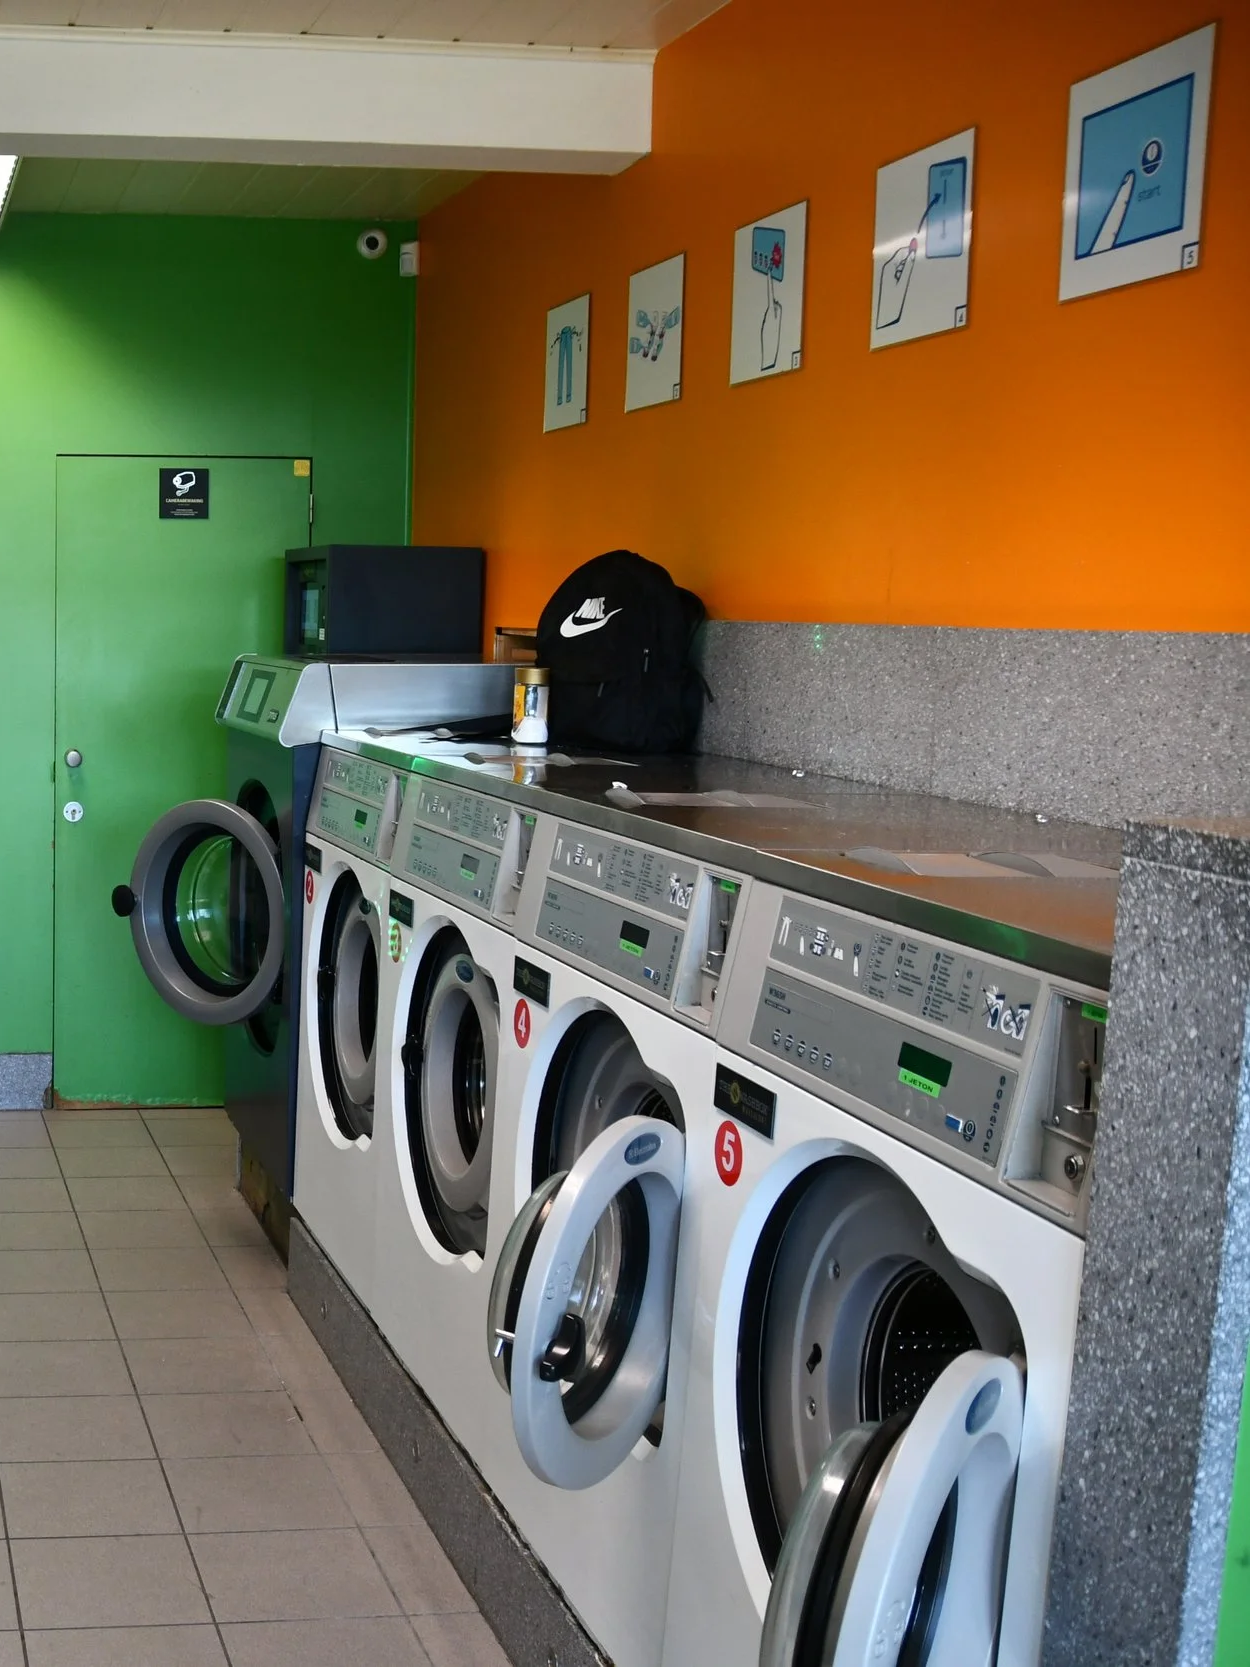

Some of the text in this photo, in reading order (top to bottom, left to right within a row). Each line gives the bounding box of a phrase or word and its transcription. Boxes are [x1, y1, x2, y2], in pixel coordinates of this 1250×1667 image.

[1137, 184, 1161, 202] start
[1187, 250, 1194, 265] 5
[574, 597, 606, 619] NIKE
[307, 875, 313, 897] 2
[517, 1007, 527, 1039] 4
[909, 1077, 934, 1093] JETON
[721, 1130, 736, 1173] 5
